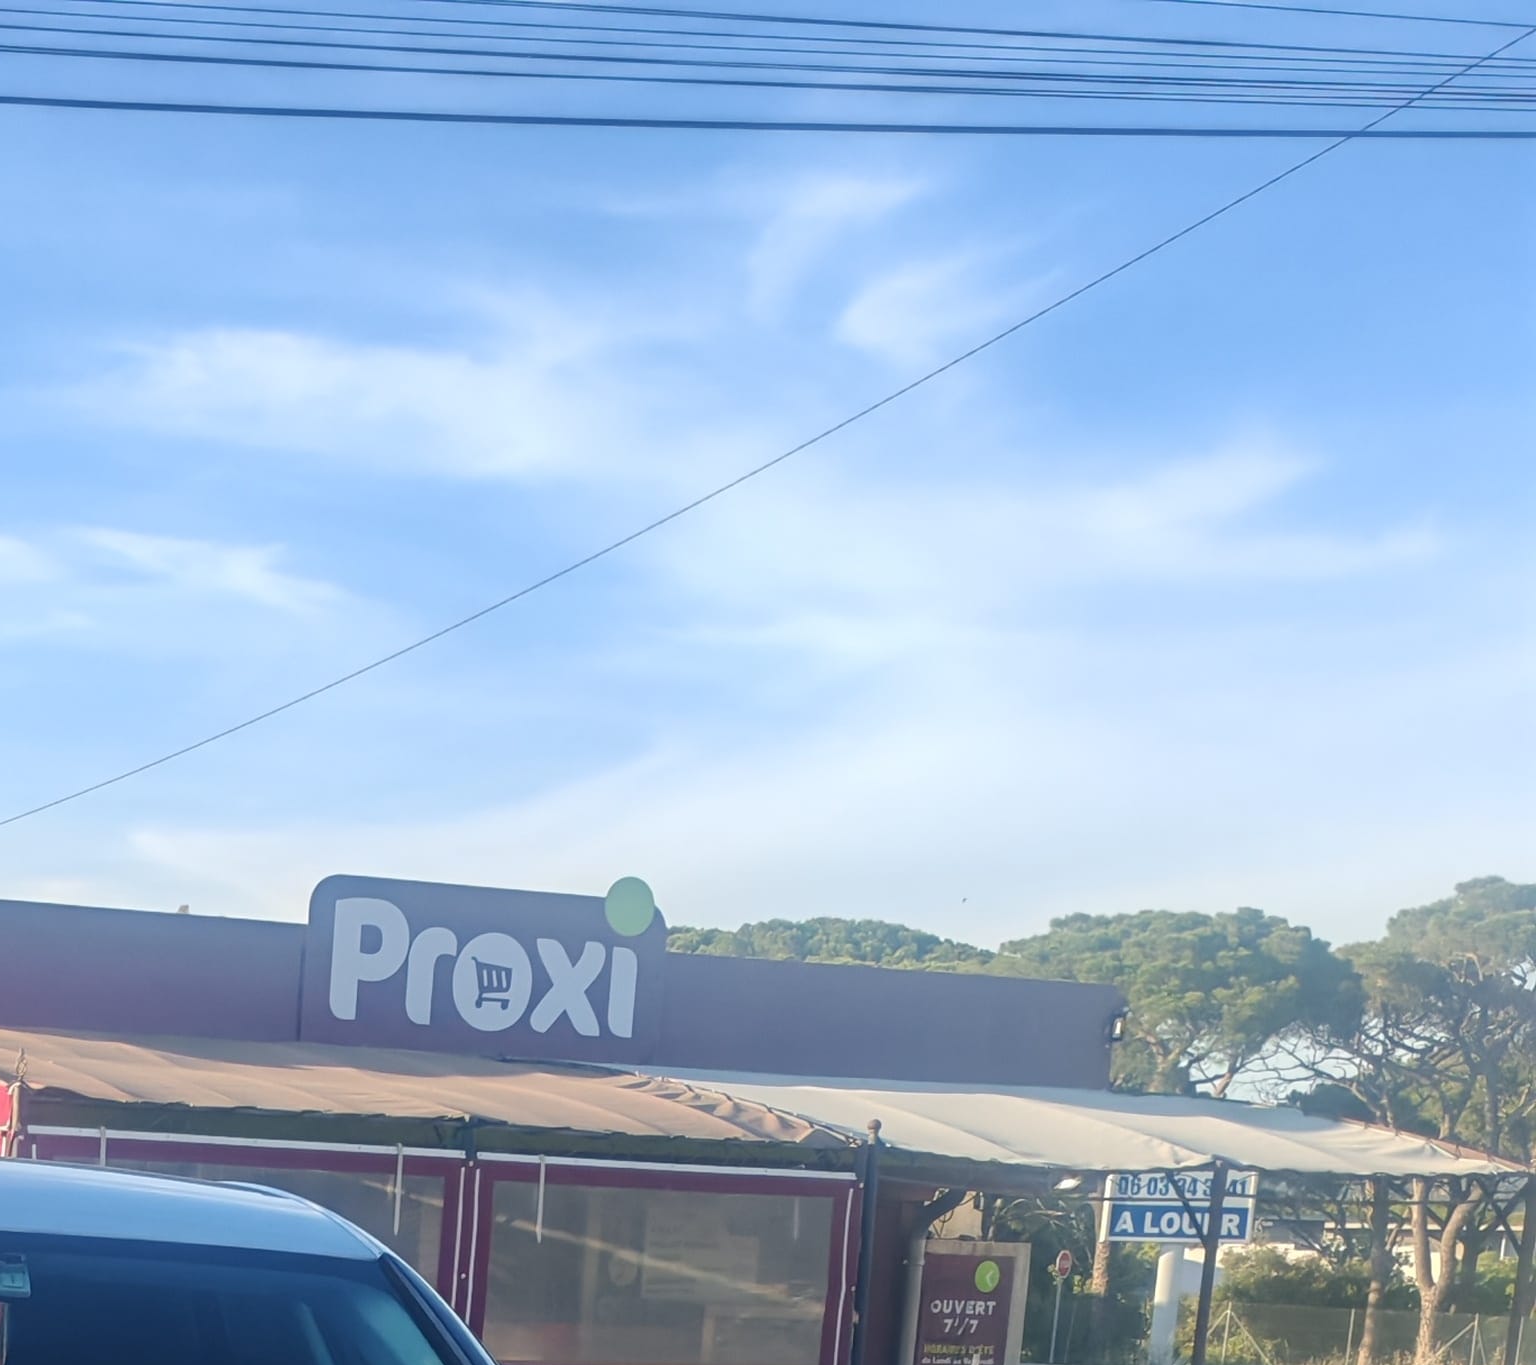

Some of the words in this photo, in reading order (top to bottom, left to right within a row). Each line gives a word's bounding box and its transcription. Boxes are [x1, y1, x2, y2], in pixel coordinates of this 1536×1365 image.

[1118, 1177, 1141, 1196] 06
[1147, 1177, 1169, 1196] 03
[1114, 1211, 1135, 1233] A
[930, 1299, 996, 1315] OUVERT
